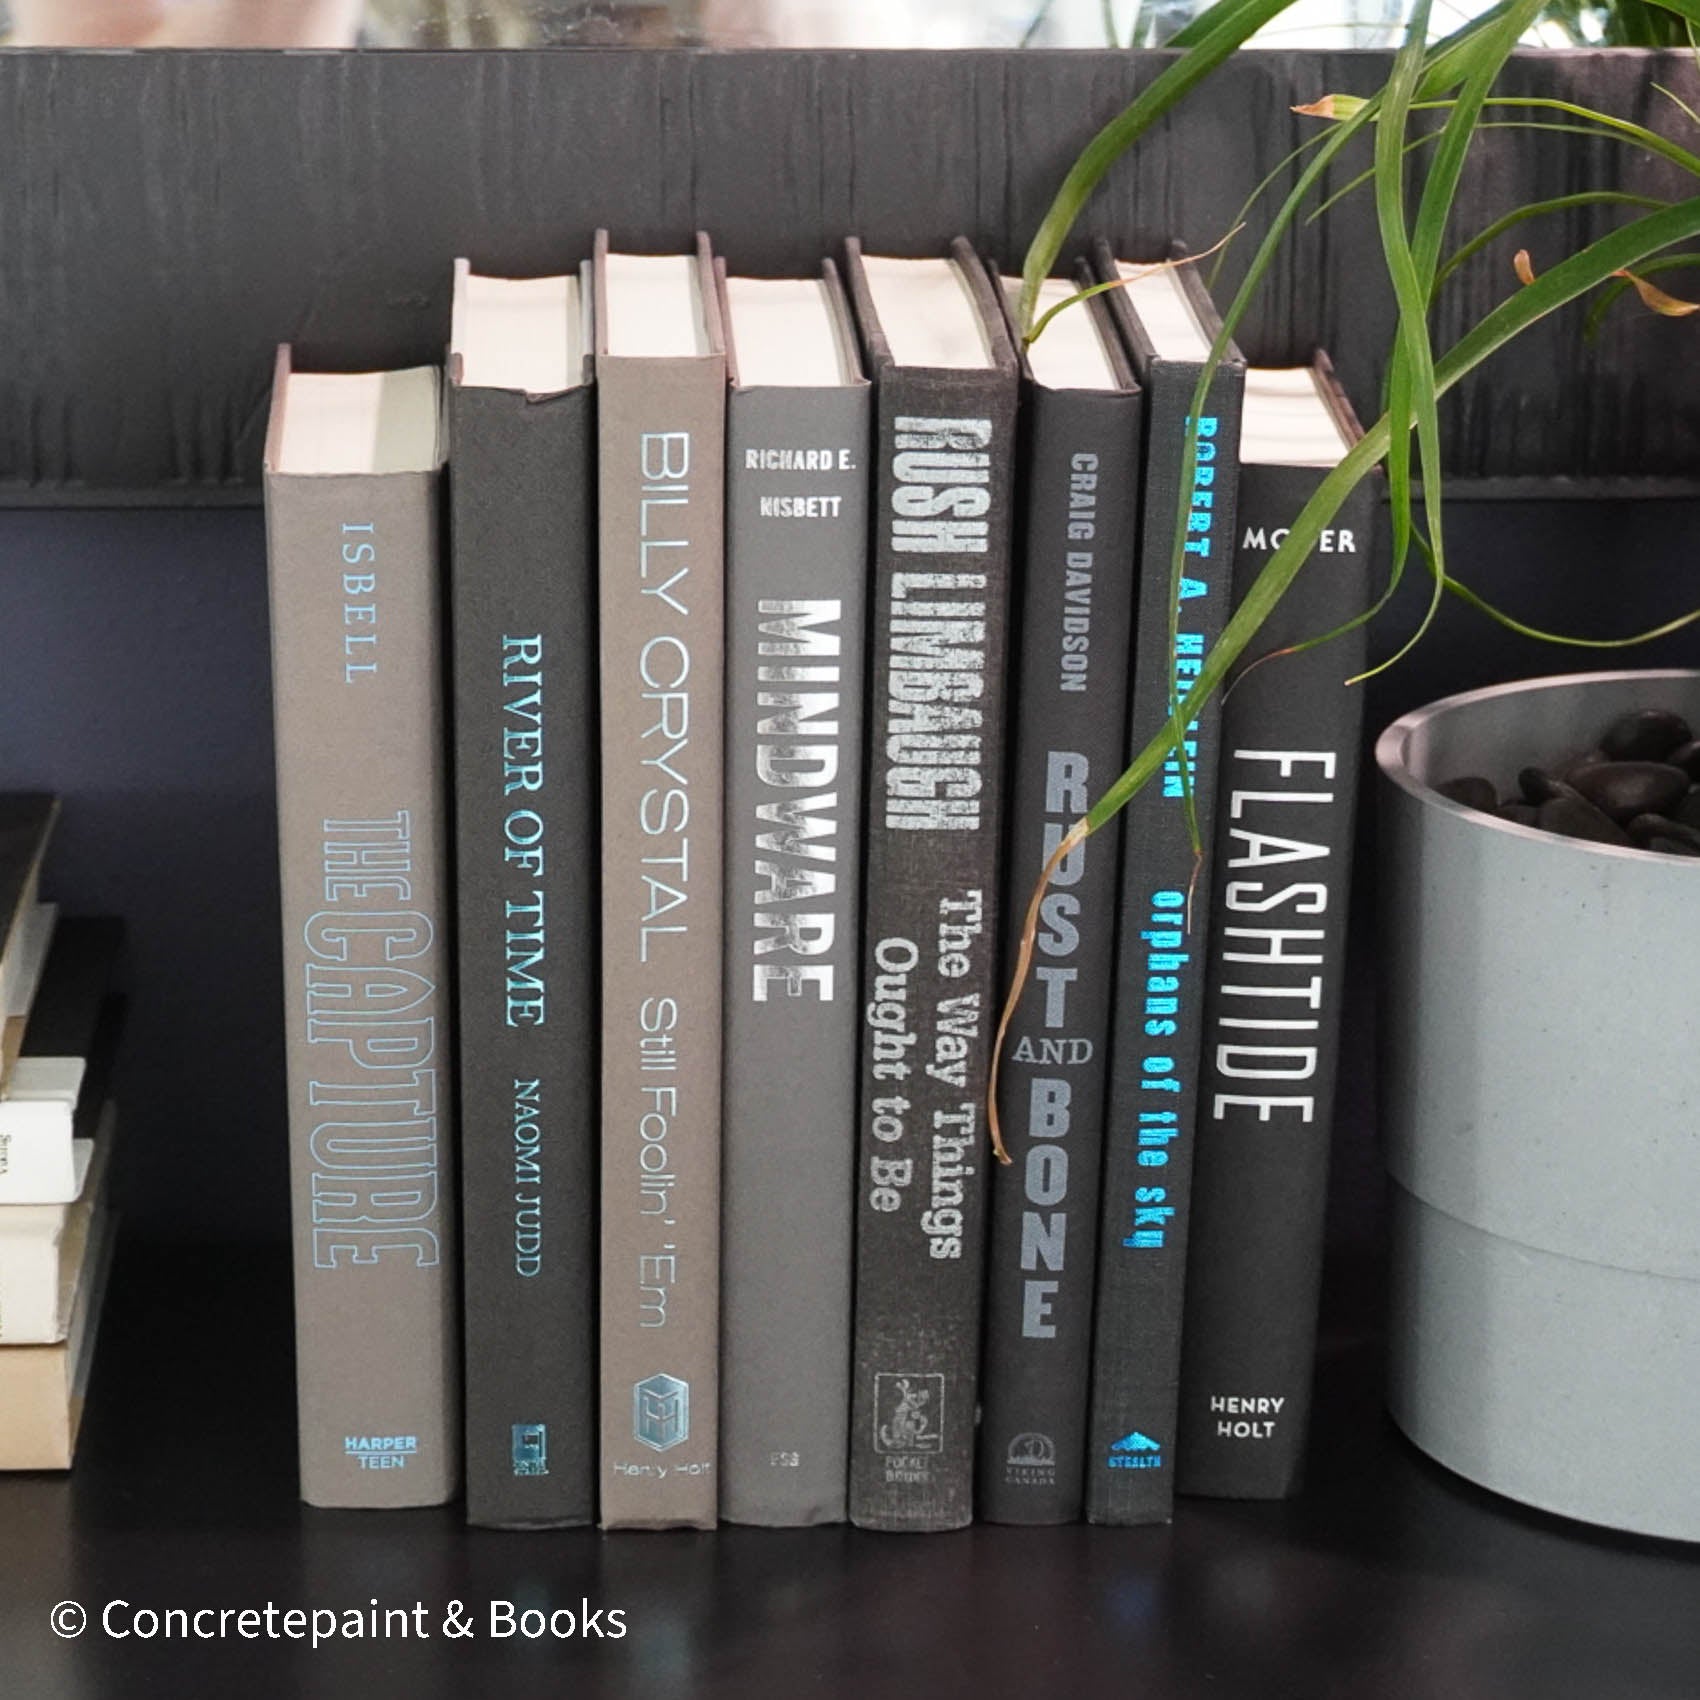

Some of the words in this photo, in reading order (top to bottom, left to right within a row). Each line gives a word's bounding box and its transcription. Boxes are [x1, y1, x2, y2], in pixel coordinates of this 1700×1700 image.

[746, 450, 832, 470] RICHARD
[839, 449, 855, 469] E.
[892, 417, 992, 552] RUSH
[1068, 453, 1098, 539] CRAIG
[642, 432, 689, 615] BILLY
[761, 496, 841, 517] NISBETT
[1241, 525, 1357, 554] MOER
[343, 524, 376, 682] ISBELL
[1061, 552, 1093, 691] DAVIDSON
[504, 635, 543, 795] RIVER
[886, 573, 987, 829] LIMBAUGH
[505, 810, 543, 876] OF
[641, 637, 689, 961] CRYSTAL
[754, 600, 841, 1001] MINDWARE
[324, 811, 410, 901] THE
[1034, 750, 1090, 1030] RUST
[506, 891, 544, 1026] TIME
[938, 890, 982, 977] The
[1141, 887, 1192, 1035] orphans
[1214, 750, 1336, 1122] FLASHTIDE
[640, 998, 677, 1070] Still
[867, 938, 918, 1080] Ought
[926, 993, 980, 1087] Way
[1013, 1036, 1093, 1064] AND
[304, 911, 437, 1268] CAPTURE
[872, 1096, 910, 1142] to
[1142, 1057, 1180, 1092] of
[515, 1080, 540, 1183] NAOMI
[640, 1087, 676, 1224] Foolin'
[1138, 1112, 1178, 1166] the
[870, 1156, 913, 1212] Be
[920, 1101, 977, 1260] Things
[1021, 1078, 1071, 1338] BONE
[1124, 1187, 1174, 1247] sky
[516, 1194, 540, 1276] JUDD
[640, 1244, 675, 1327] 'Em
[346, 1437, 416, 1452] HARPER
[1212, 1397, 1284, 1413] HENRY
[1218, 1422, 1275, 1438] HOLT
[359, 1453, 404, 1468] TEEN
